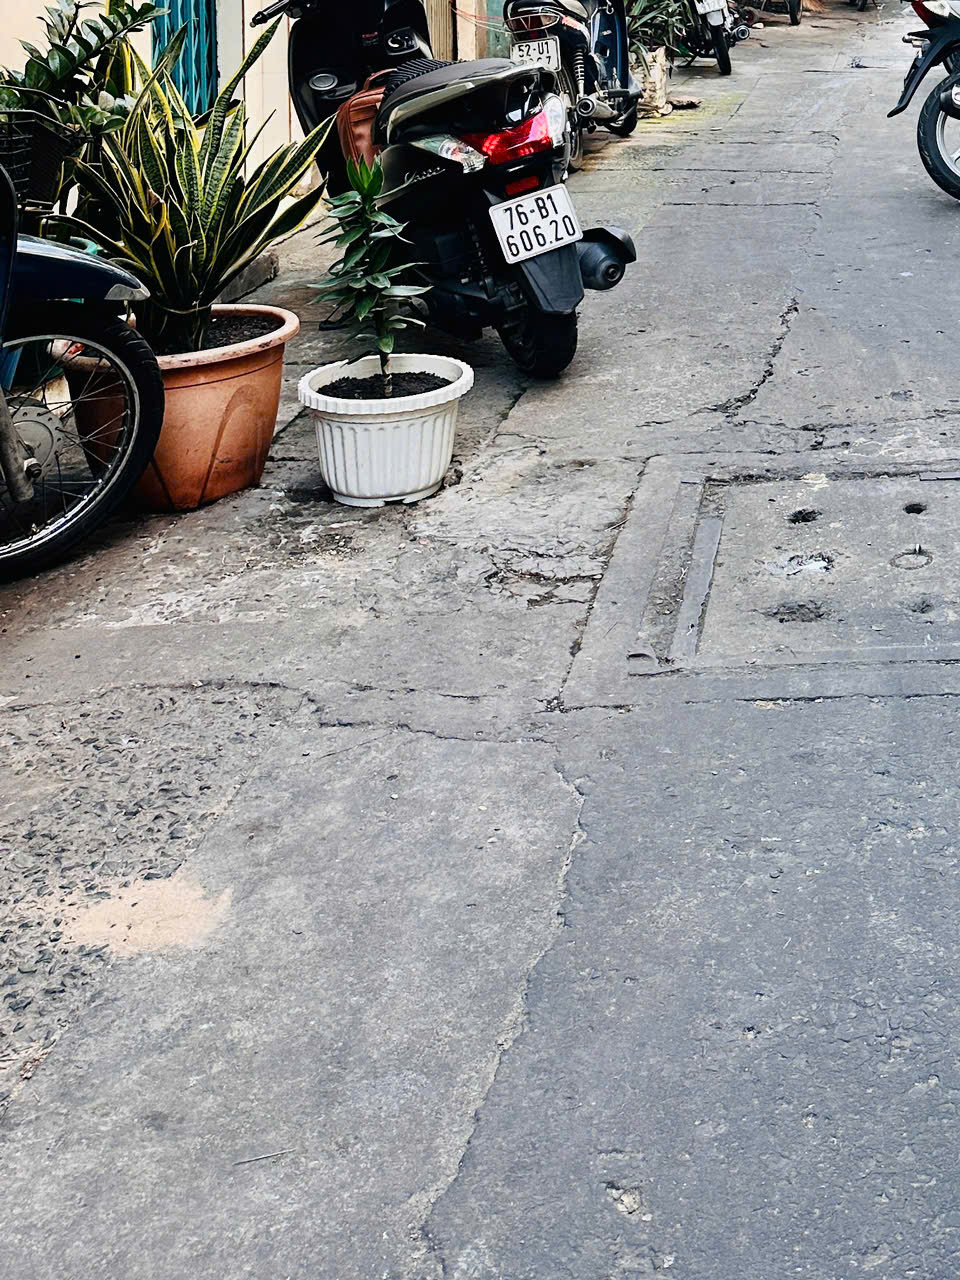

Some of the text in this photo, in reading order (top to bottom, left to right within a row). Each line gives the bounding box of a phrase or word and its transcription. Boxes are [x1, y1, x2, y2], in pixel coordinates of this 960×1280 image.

[518, 41, 550, 58] 52-U1
[504, 193, 559, 231] 76-B1
[506, 215, 576, 257] 606.20
